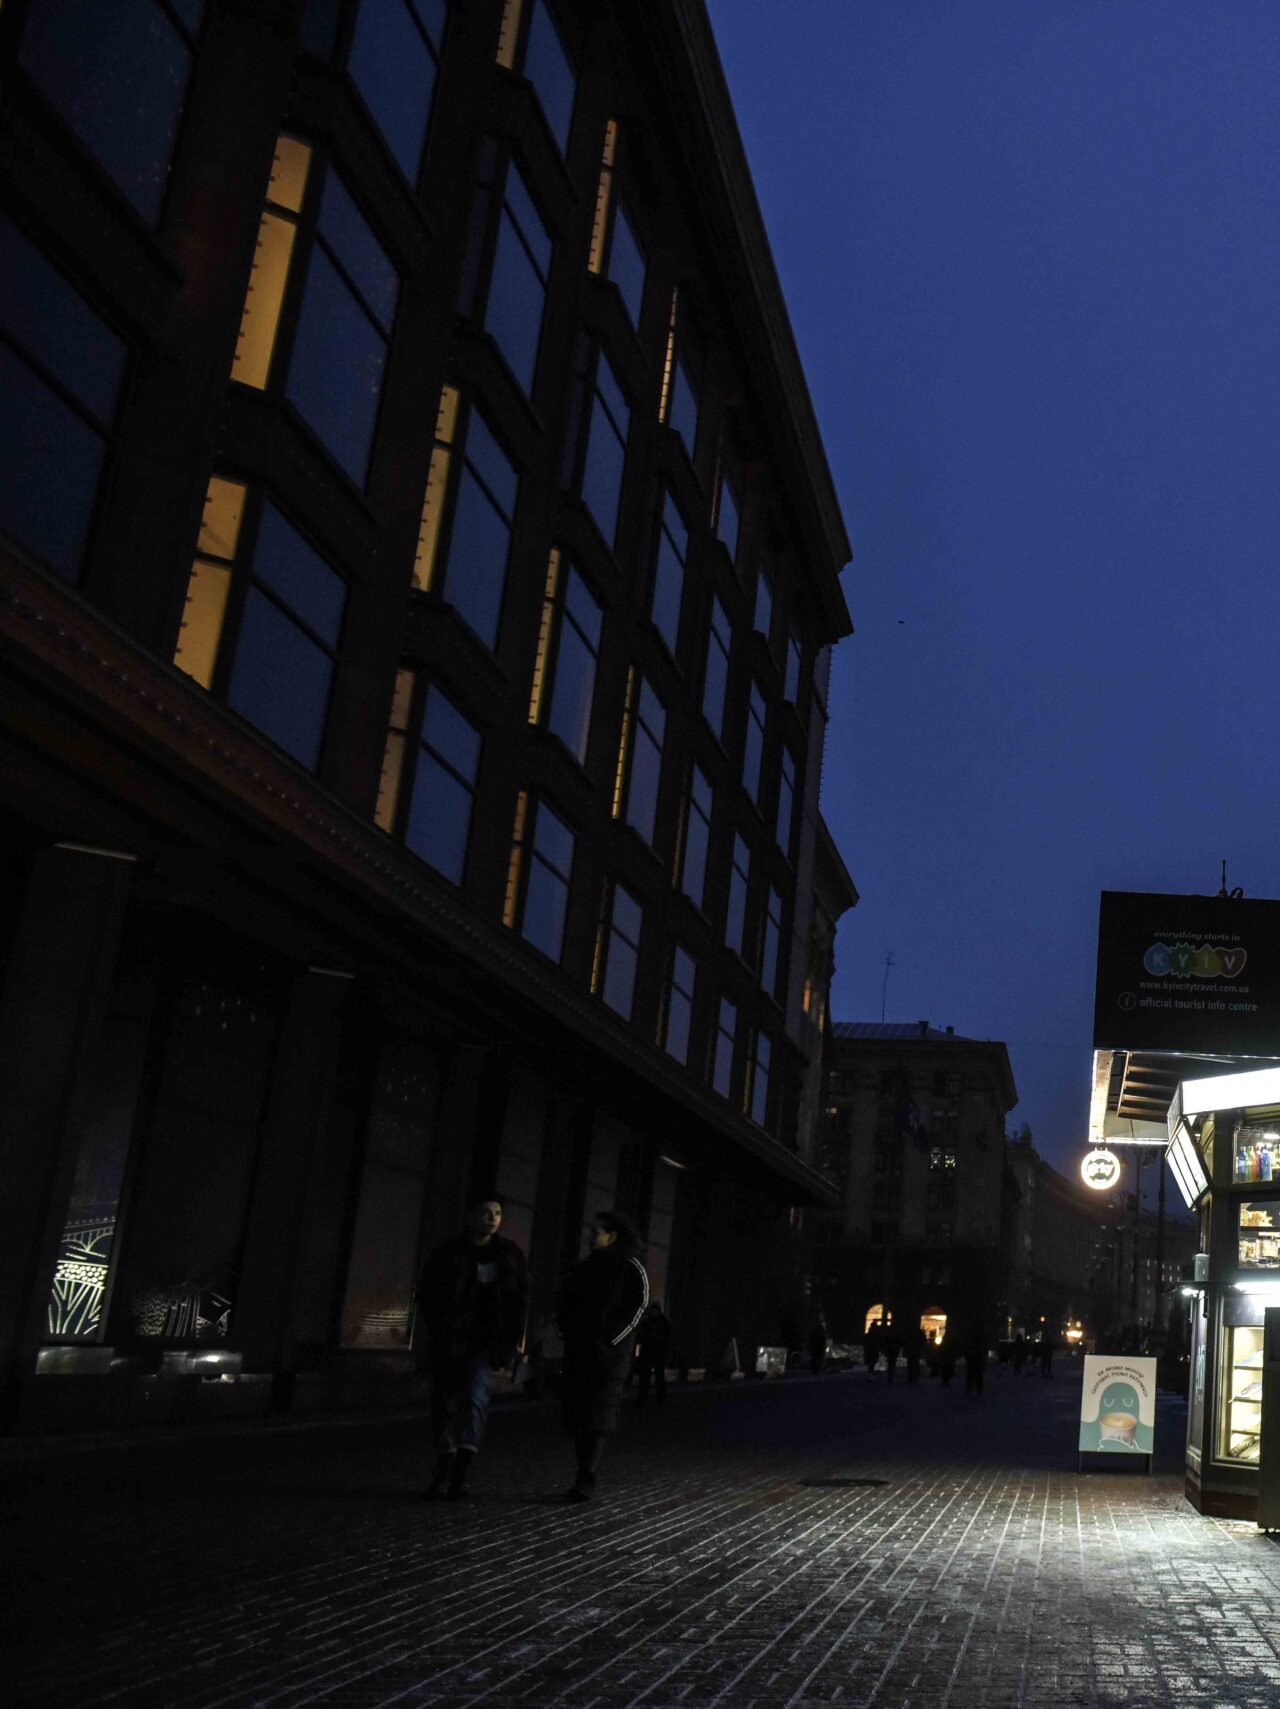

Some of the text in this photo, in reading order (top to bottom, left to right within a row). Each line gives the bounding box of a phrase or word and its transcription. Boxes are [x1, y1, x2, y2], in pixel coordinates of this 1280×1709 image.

[1231, 932, 1240, 941] in
[1139, 996, 1258, 1012] official tourist info centre
